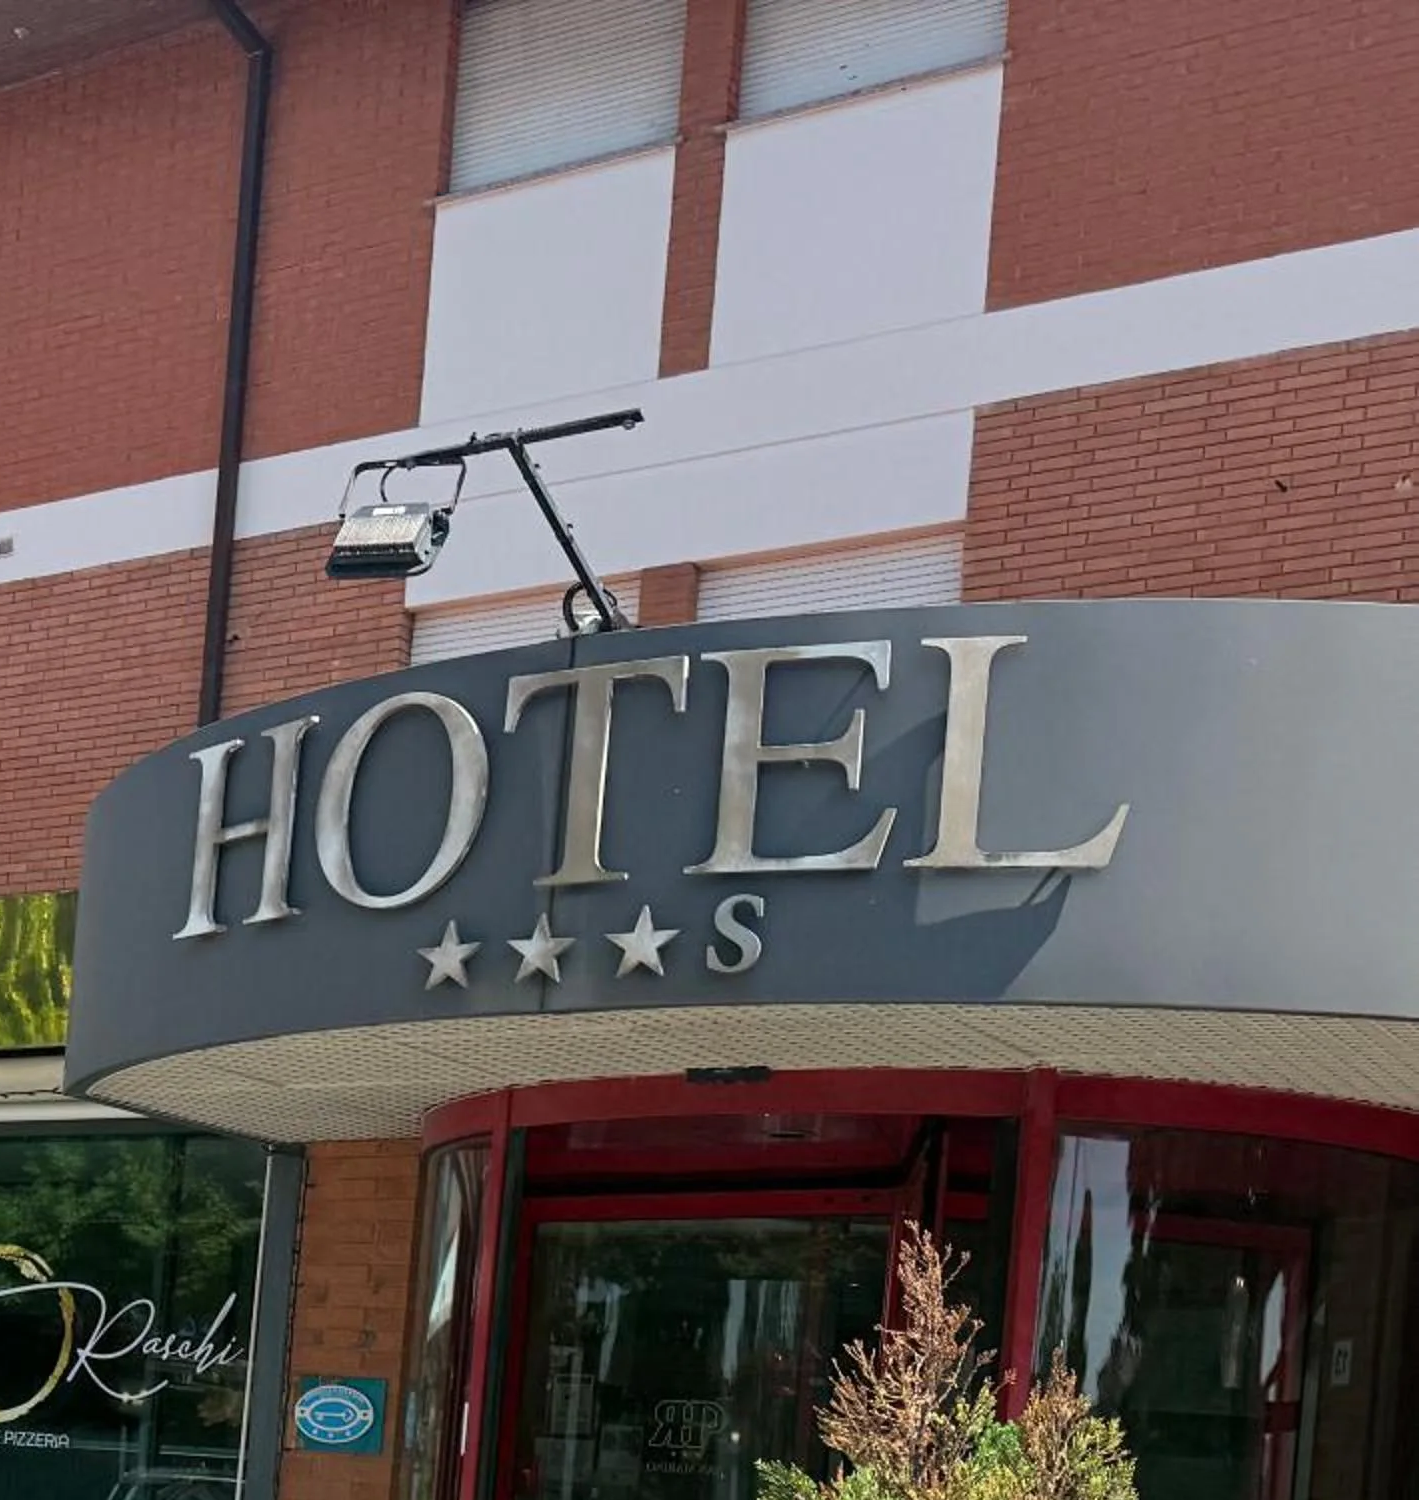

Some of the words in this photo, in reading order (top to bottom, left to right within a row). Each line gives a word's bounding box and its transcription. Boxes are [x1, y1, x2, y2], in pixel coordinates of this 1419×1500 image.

[172, 634, 1129, 940] HOTEL
[706, 893, 764, 972] S
[3, 1430, 71, 1449] PIZZERIA
